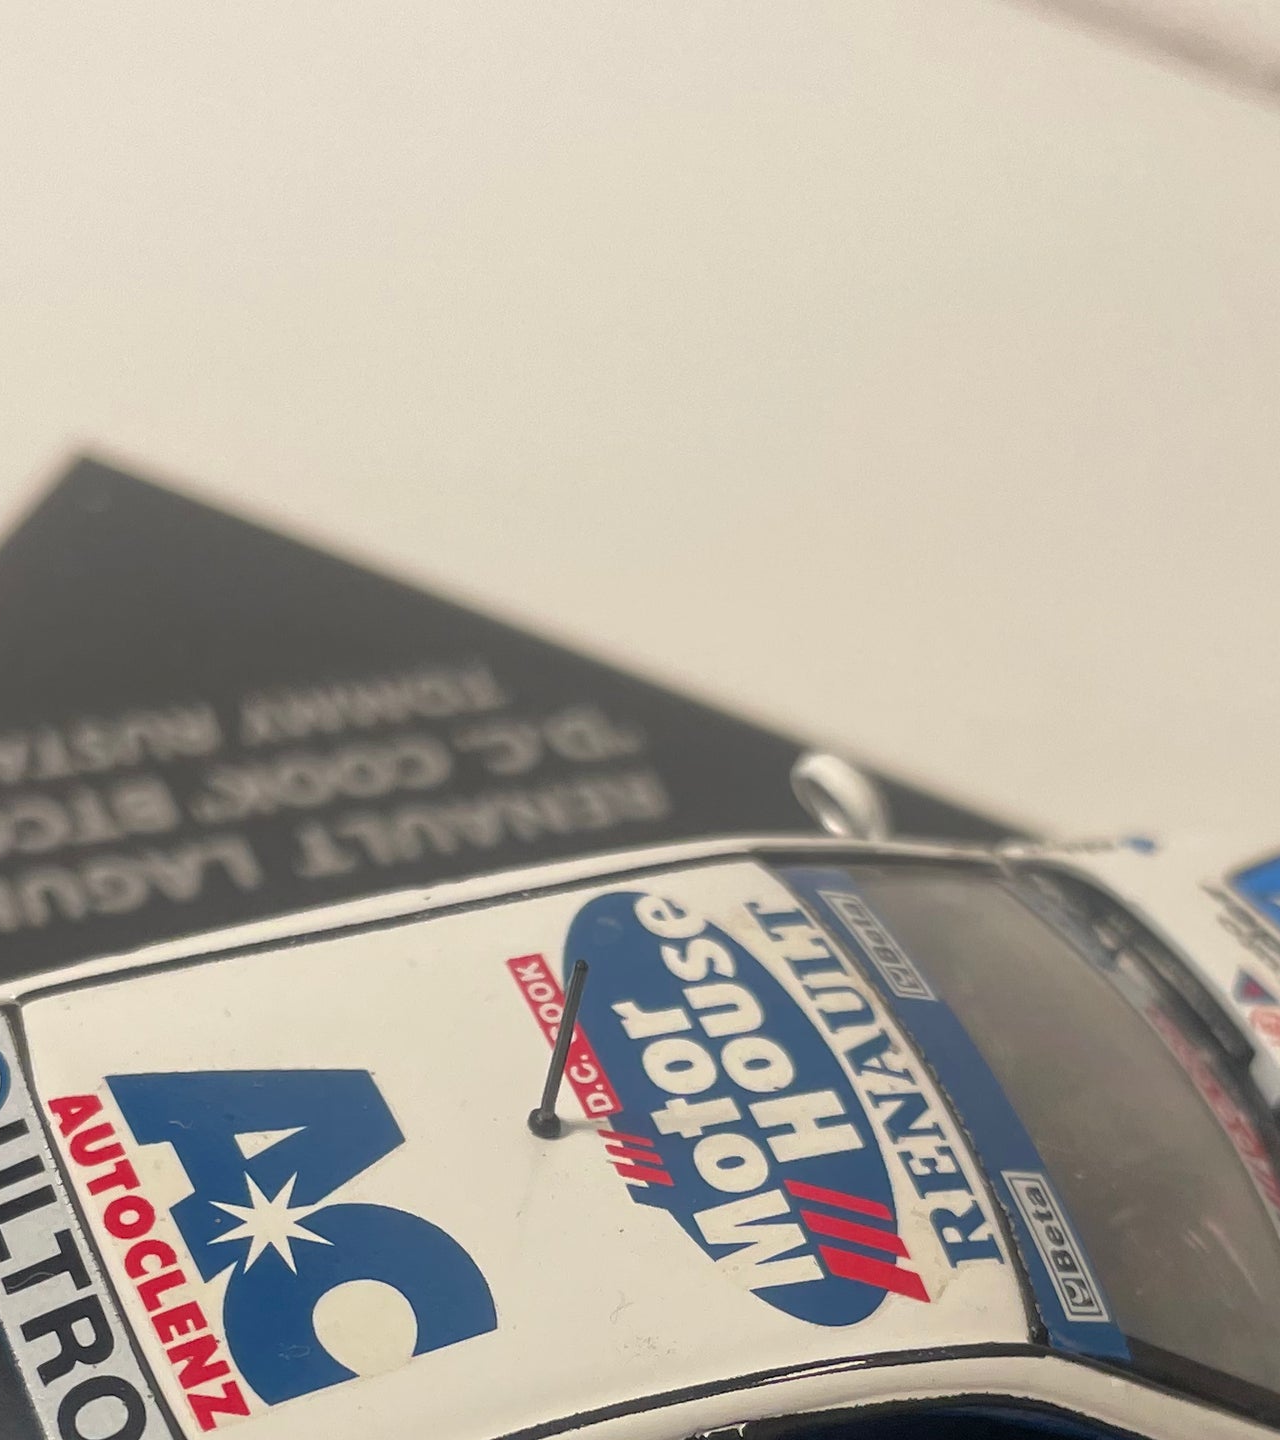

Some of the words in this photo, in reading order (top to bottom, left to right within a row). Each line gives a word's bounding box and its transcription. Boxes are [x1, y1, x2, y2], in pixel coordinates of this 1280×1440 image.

[293, 768, 676, 882] RENAULT
[613, 1002, 824, 1291] Motor
[633, 894, 864, 1163] House
[745, 901, 1004, 1268] RENAULT
[48, 1094, 251, 1431] AUTOCLENZ
[105, 1069, 498, 1406] AC
[1025, 1185, 1078, 1275] Beta
